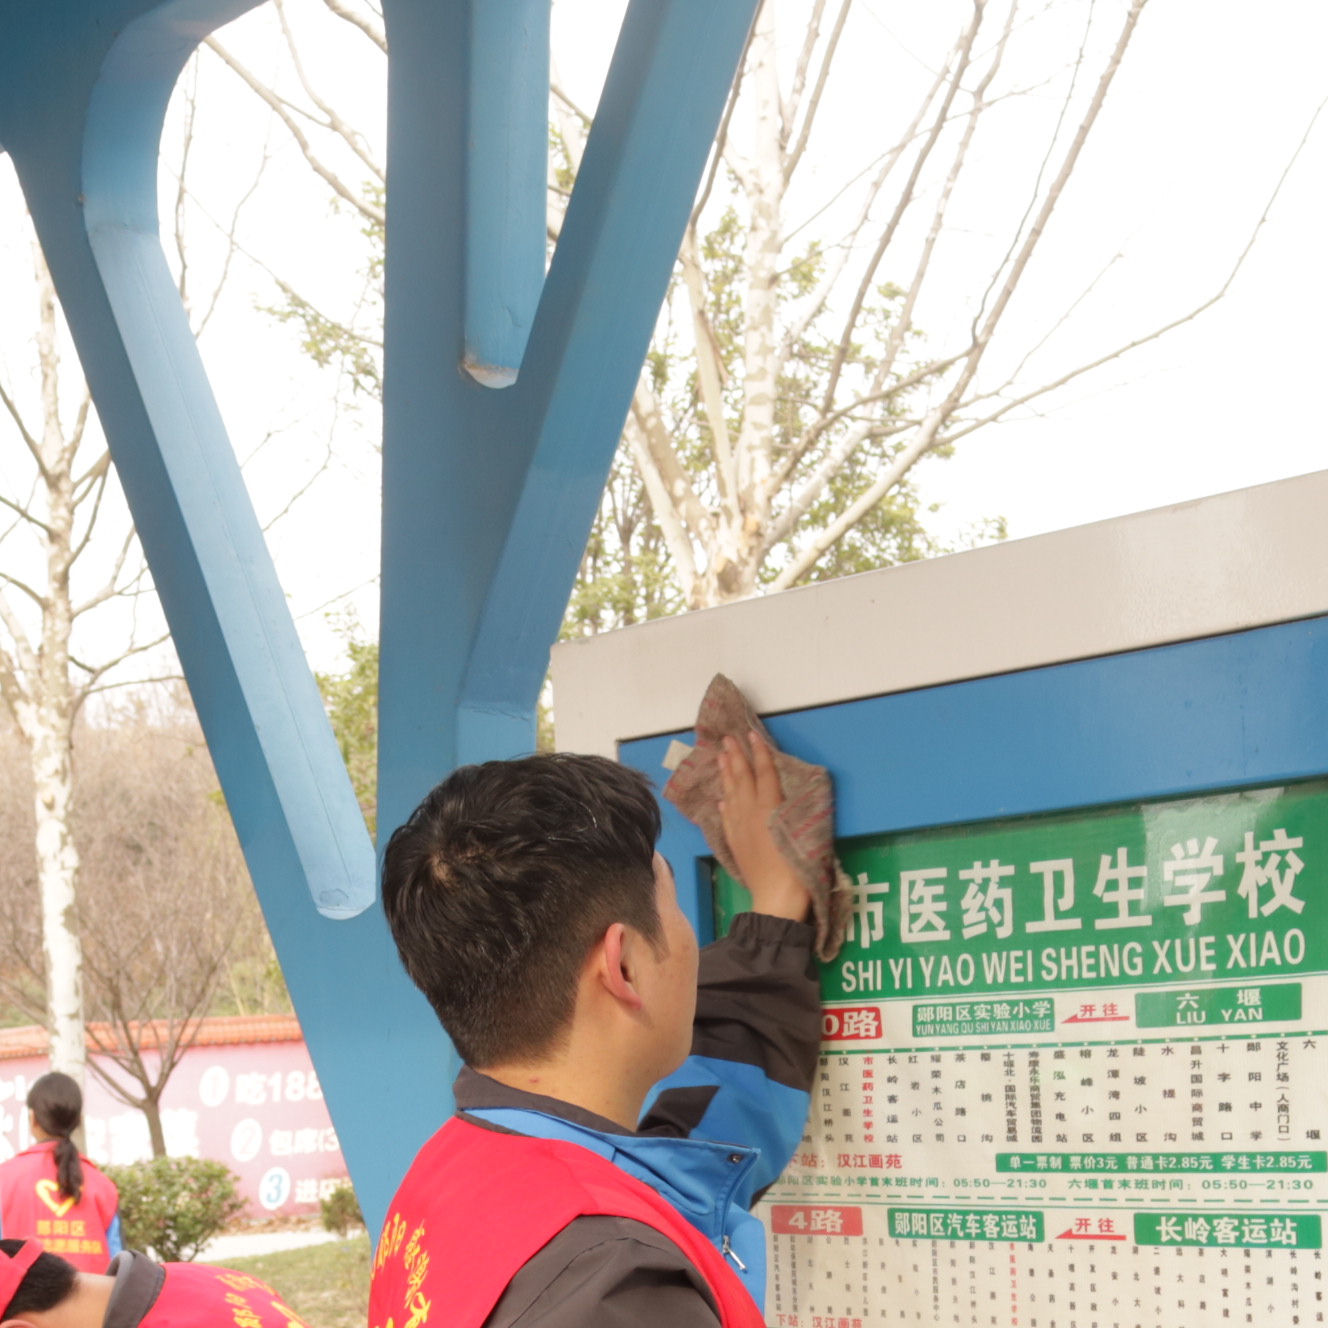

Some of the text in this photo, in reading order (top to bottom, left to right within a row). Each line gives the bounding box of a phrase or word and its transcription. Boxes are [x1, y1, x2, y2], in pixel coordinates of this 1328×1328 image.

[841, 929, 1306, 992] SHI YI YAO WEI SHENG XUE XIAO
[1176, 988, 1262, 1009] 六堰
[918, 1000, 1051, 1021] 郧阳区实验小学
[1080, 1003, 1118, 1017] 开往
[1176, 1008, 1263, 1024] LIU YAN
[916, 1019, 1051, 1035] YUN YANG QU SHI YAN XIAO XUE
[1009, 1155, 1312, 1170] 单一票制 票价3元 普通卡2.85元 学生卡2.85元
[788, 1210, 844, 1234] 4路
[895, 1212, 1037, 1239] 郧阳区汽车客运站
[1075, 1218, 1114, 1233] 开往
[1156, 1216, 1298, 1246] 长岭客运站
